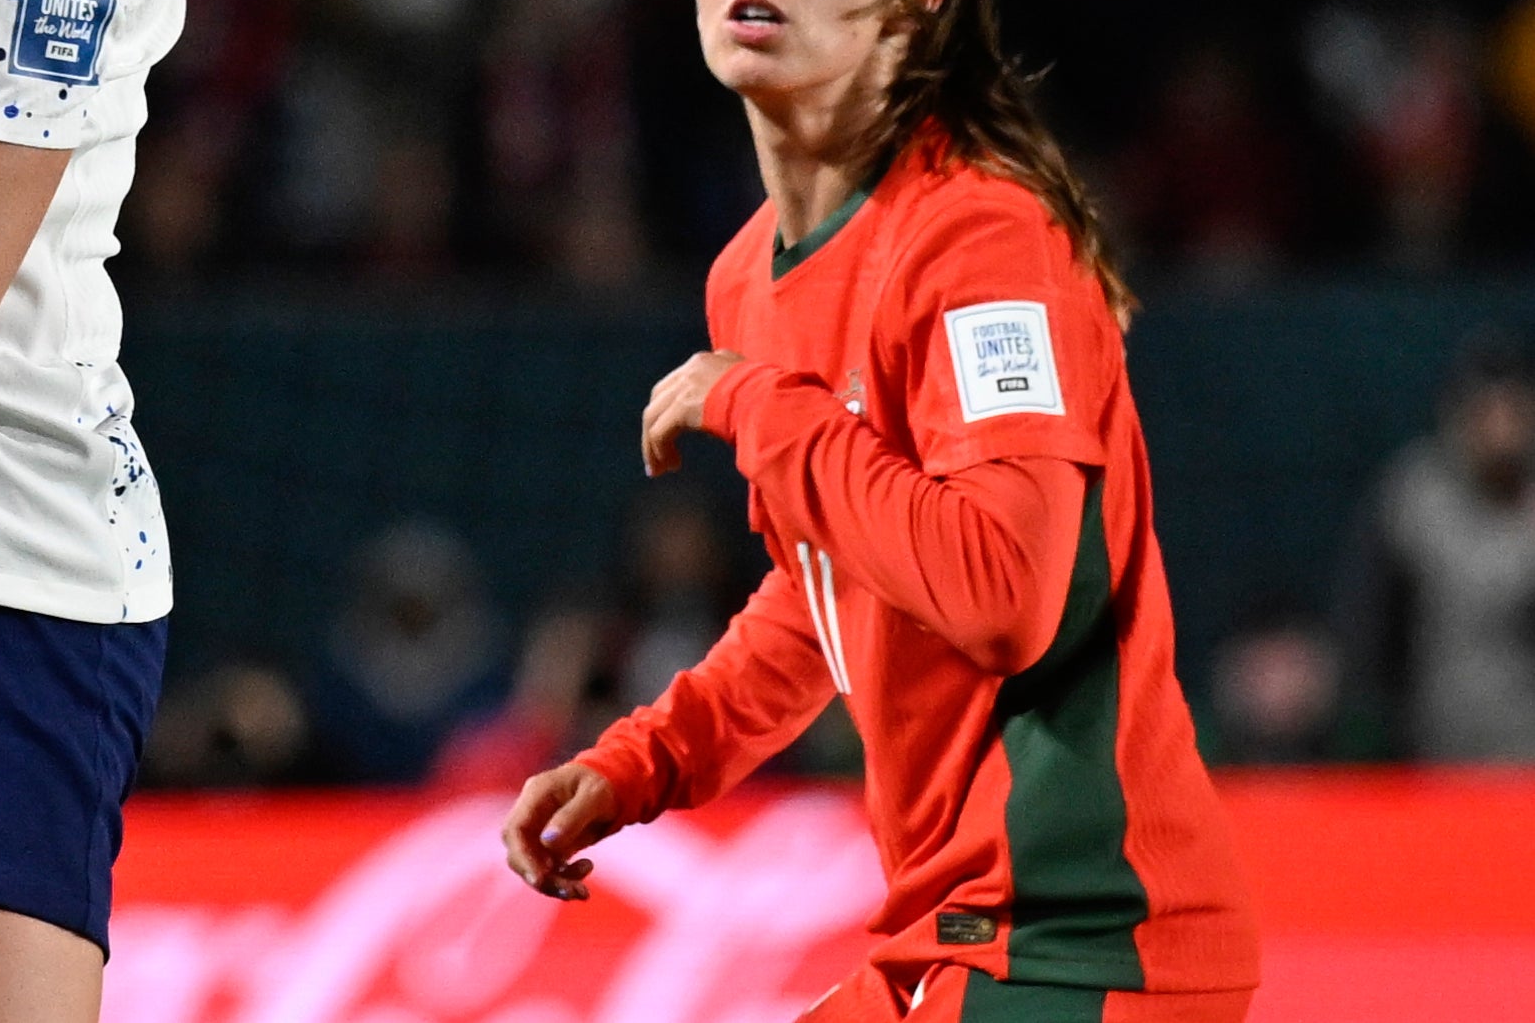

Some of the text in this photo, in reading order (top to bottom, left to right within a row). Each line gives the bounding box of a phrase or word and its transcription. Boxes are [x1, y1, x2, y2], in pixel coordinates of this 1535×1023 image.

[33, 16, 95, 44] the World
[51, 45, 74, 57] FIFA
[972, 321, 1030, 339] FOOTBALL
[975, 336, 1034, 359] UNITES
